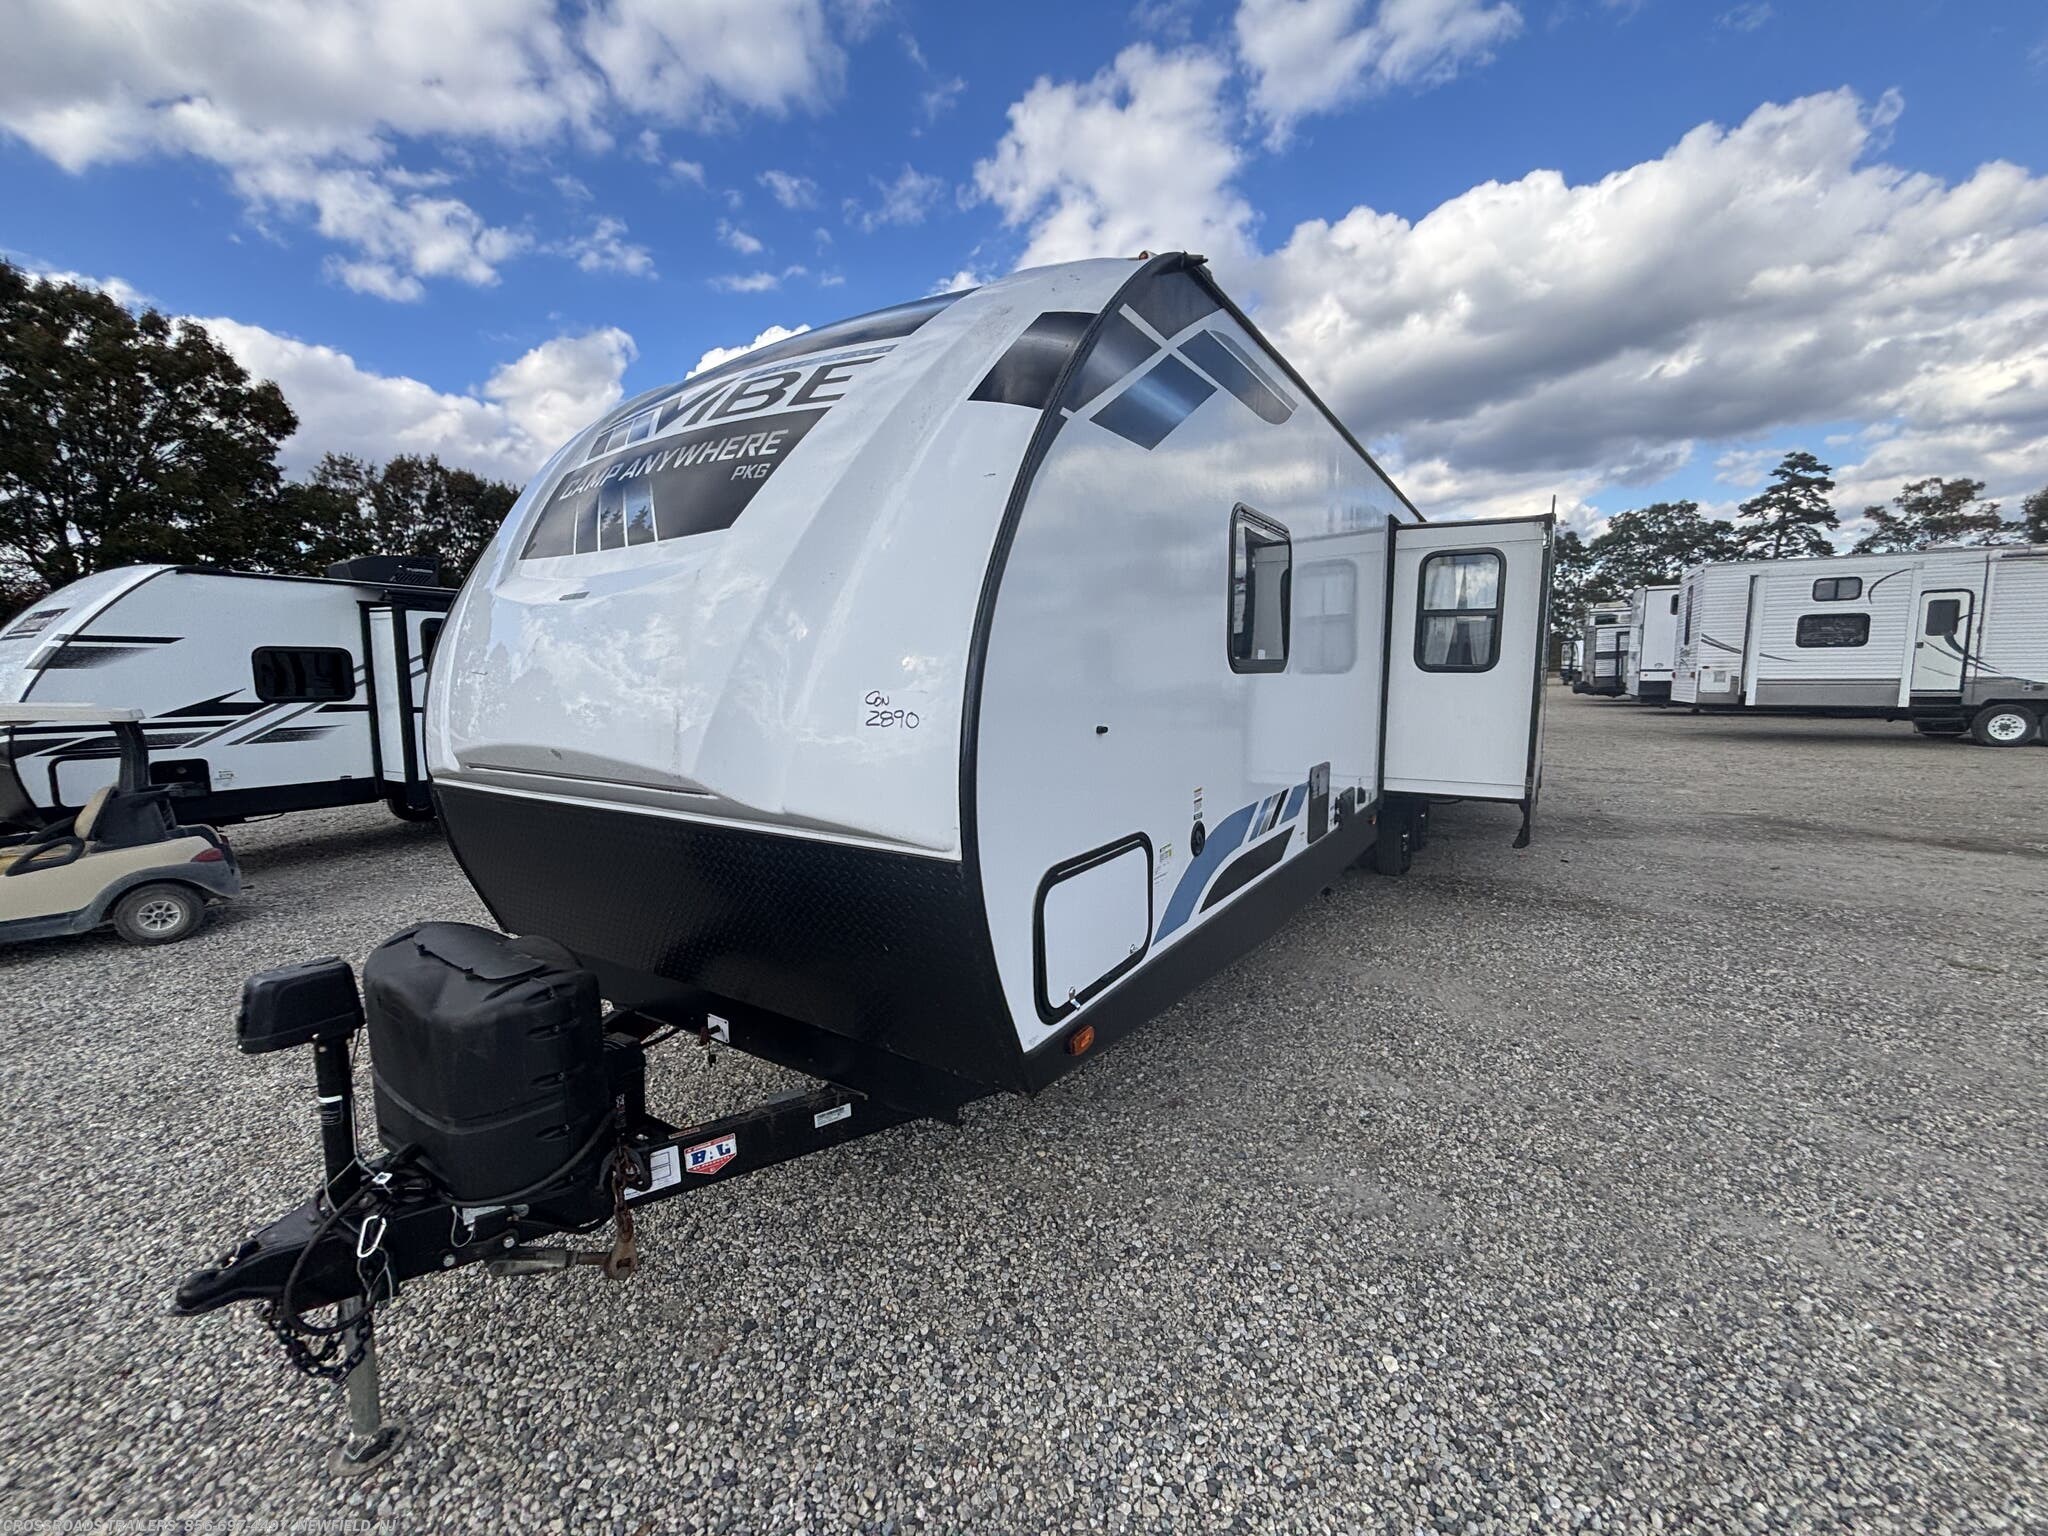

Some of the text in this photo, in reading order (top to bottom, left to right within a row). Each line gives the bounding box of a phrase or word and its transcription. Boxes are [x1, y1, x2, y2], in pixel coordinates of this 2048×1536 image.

[655, 355, 886, 434] VIBE
[559, 429, 789, 501] CAMP ANYWHERE
[730, 462, 771, 481] PKG
[865, 709, 920, 729] 2890
